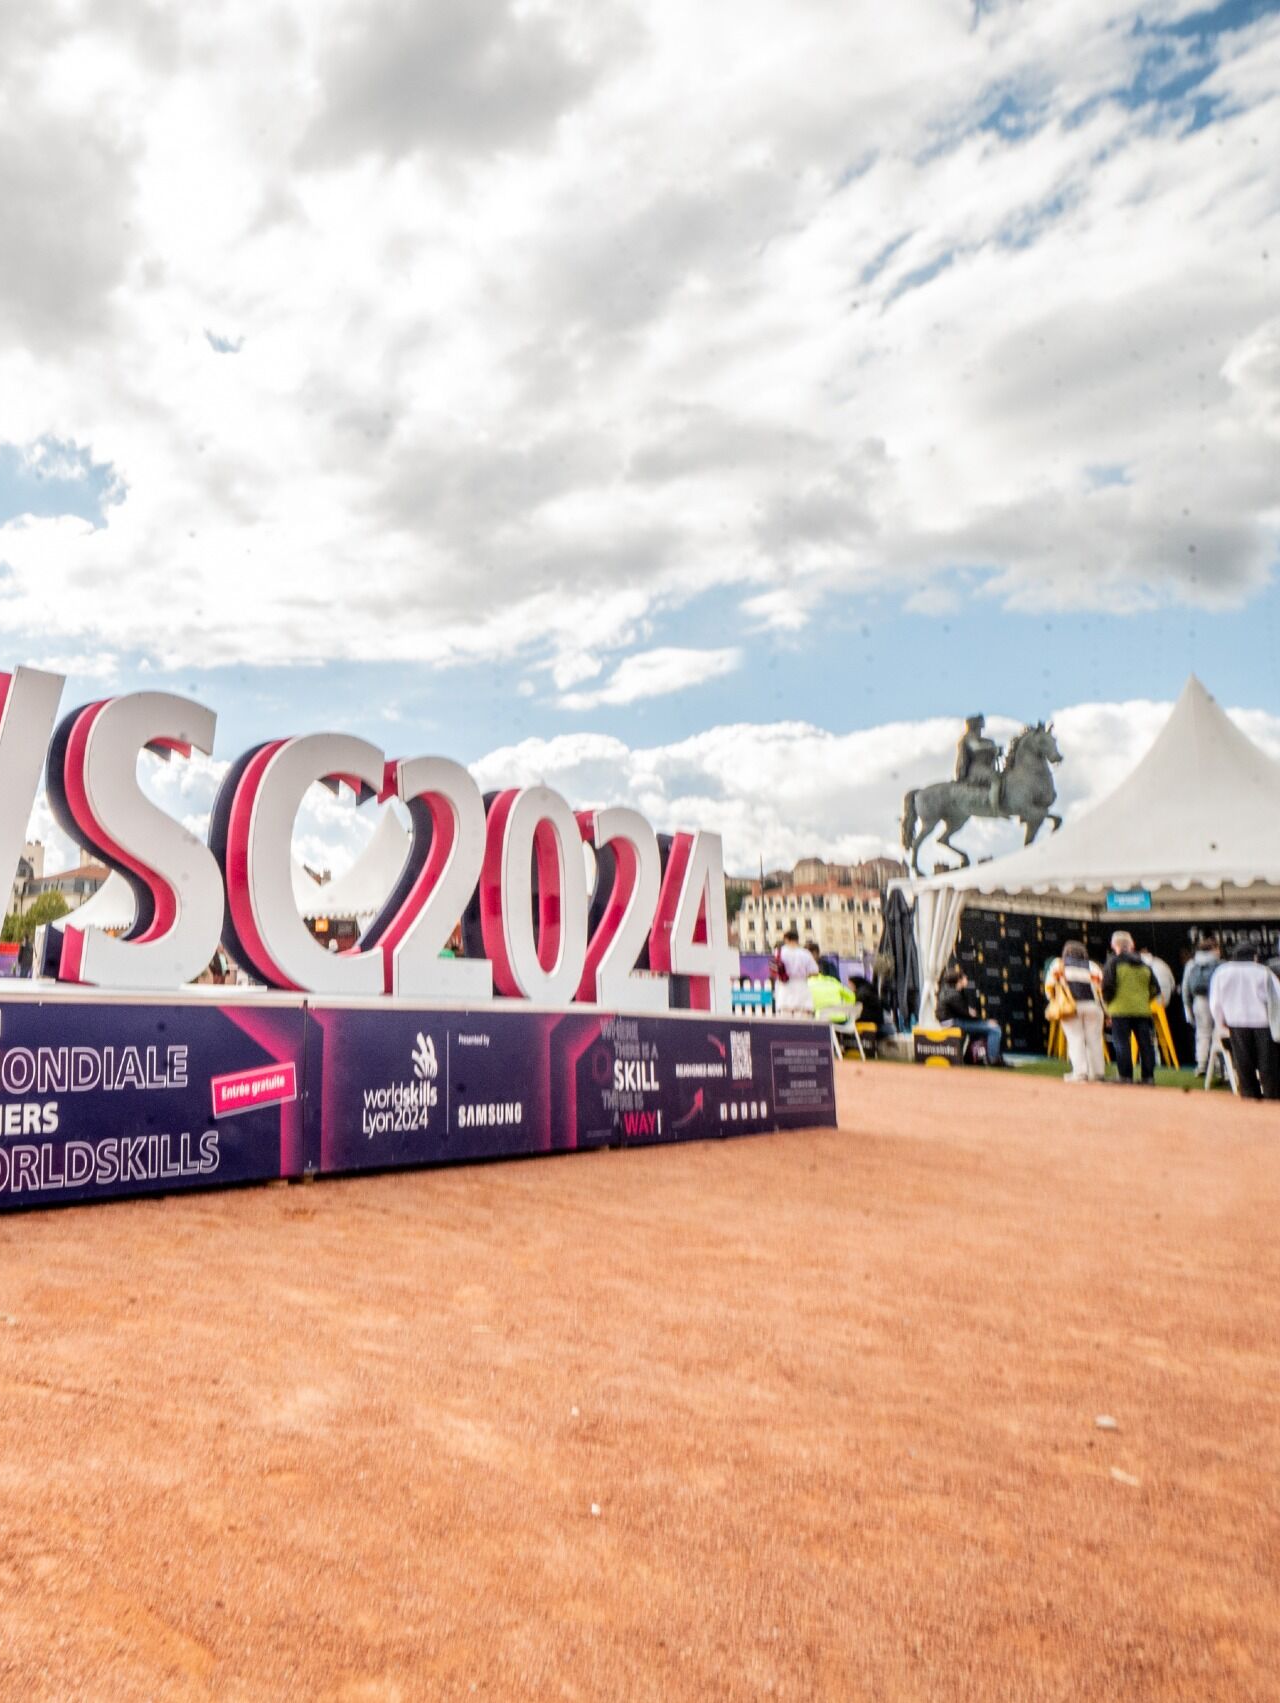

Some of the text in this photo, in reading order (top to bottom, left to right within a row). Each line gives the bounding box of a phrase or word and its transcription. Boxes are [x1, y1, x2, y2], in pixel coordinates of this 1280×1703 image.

[221, 1073, 286, 1100] Entrée gratuite
[614, 1058, 660, 1091] SKILL
[363, 1080, 438, 1109] worldskills
[363, 1104, 428, 1139] Lyon2024
[458, 1102, 522, 1128] SAMSUNG
